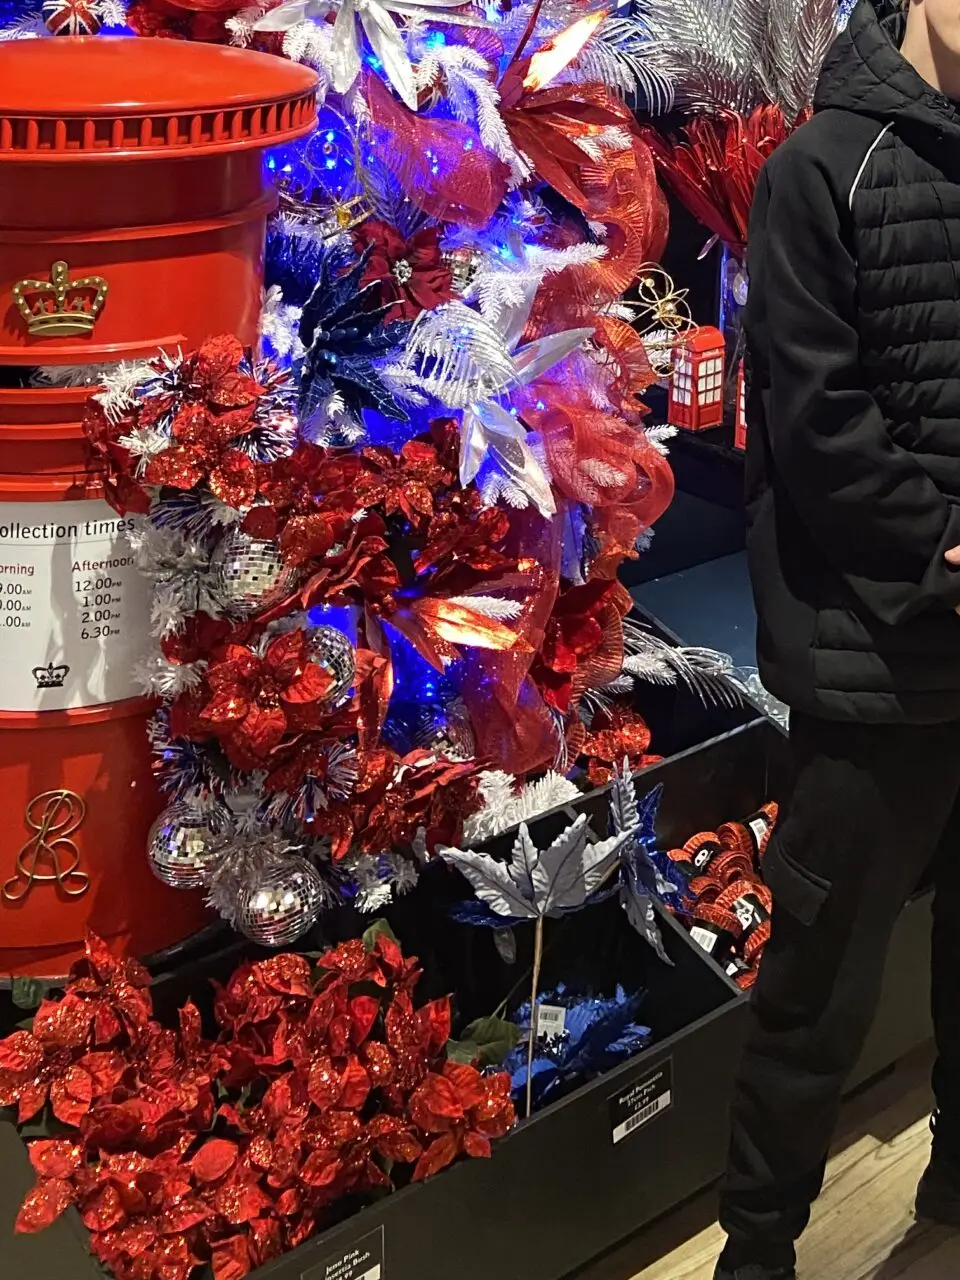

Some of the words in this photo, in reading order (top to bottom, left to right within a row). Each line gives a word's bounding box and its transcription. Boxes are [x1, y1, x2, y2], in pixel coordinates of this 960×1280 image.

[84, 518, 135, 536] times
[71, 557, 135, 573] Afternoon
[0, 616, 31, 628] .00AM
[343, 1249, 360, 1263] Pink
